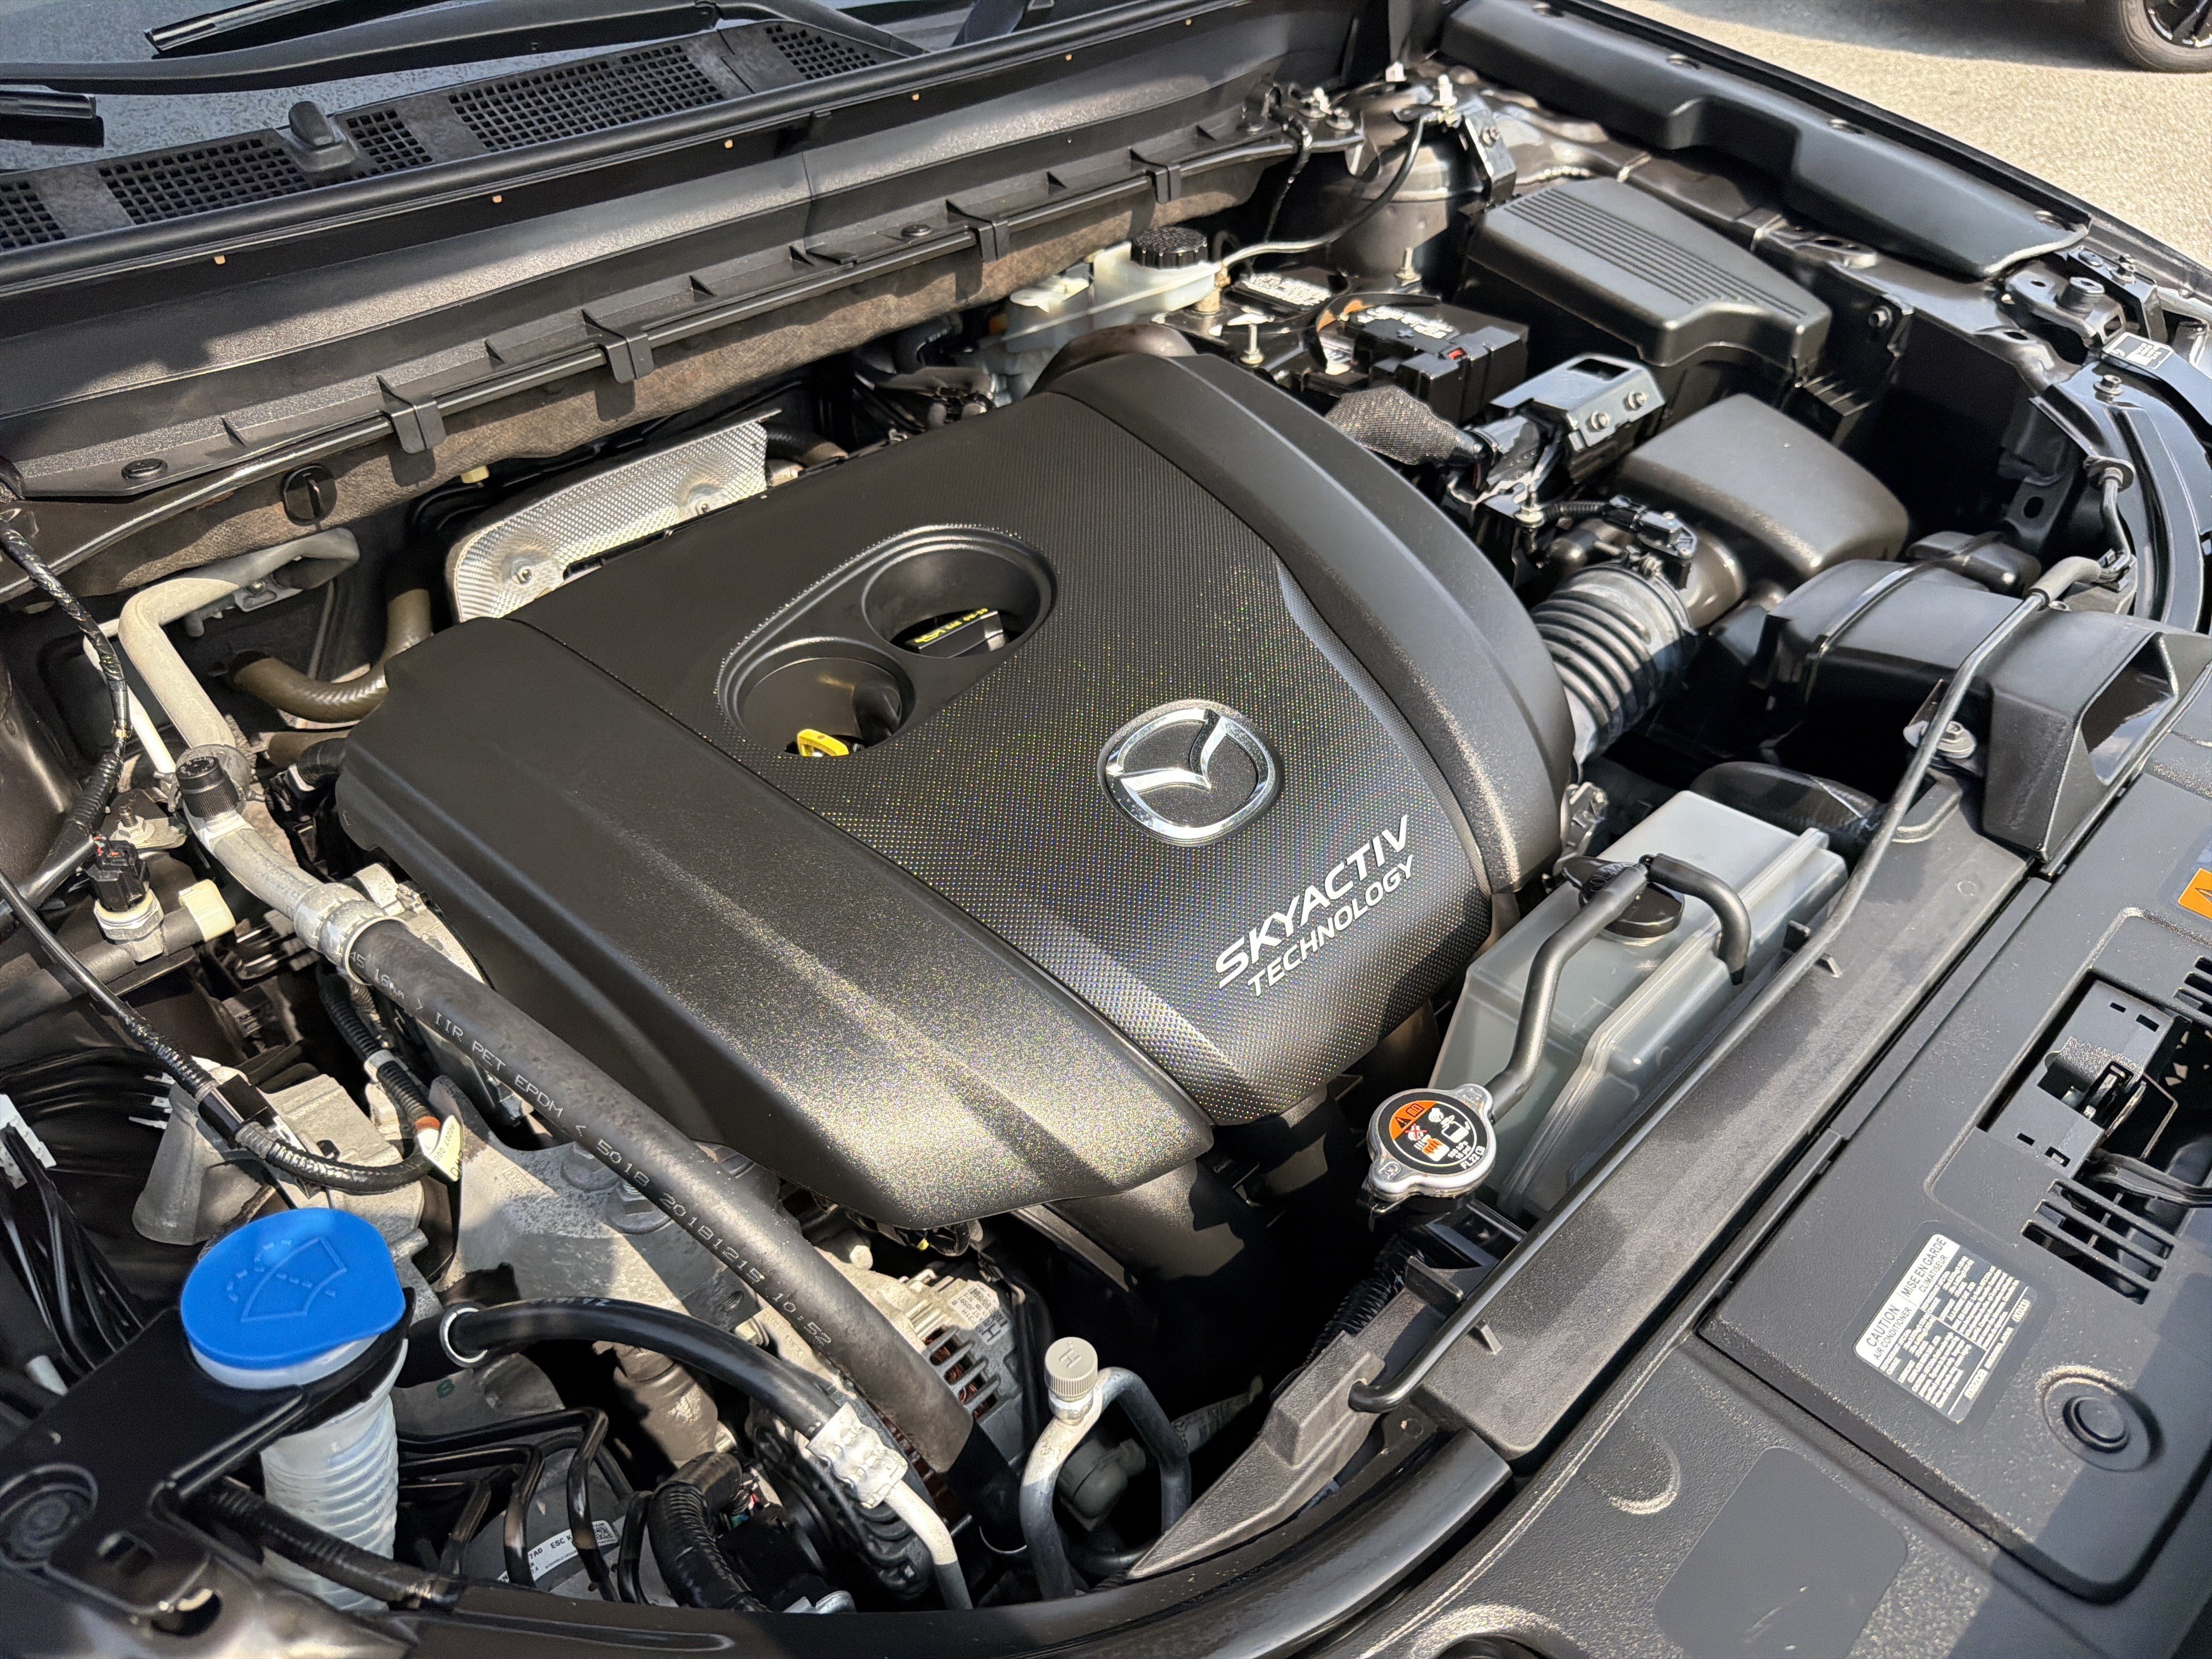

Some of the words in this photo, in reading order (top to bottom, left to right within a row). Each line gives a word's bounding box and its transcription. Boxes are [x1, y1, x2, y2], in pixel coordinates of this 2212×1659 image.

[1216, 814, 1409, 990] SKYACTIV
[1248, 854, 1414, 997] TECHNOLOGY
[435, 1012, 464, 1042] IIR
[472, 1041, 506, 1071] PET
[514, 1074, 563, 1118] EPDM
[1460, 1153, 1480, 1170] FL22
[1914, 1263, 1929, 1278] EN
[1921, 1237, 1946, 1267] GARDE
[1900, 1274, 1921, 1297] MISE
[1917, 1254, 1948, 1293] CLIMATISEUR
[1865, 1304, 1900, 1348] CAUTION
[1874, 1347, 1886, 1360] AIR
[1881, 1306, 1912, 1349] CONDITIONER
[550, 1539, 566, 1549] ESC
